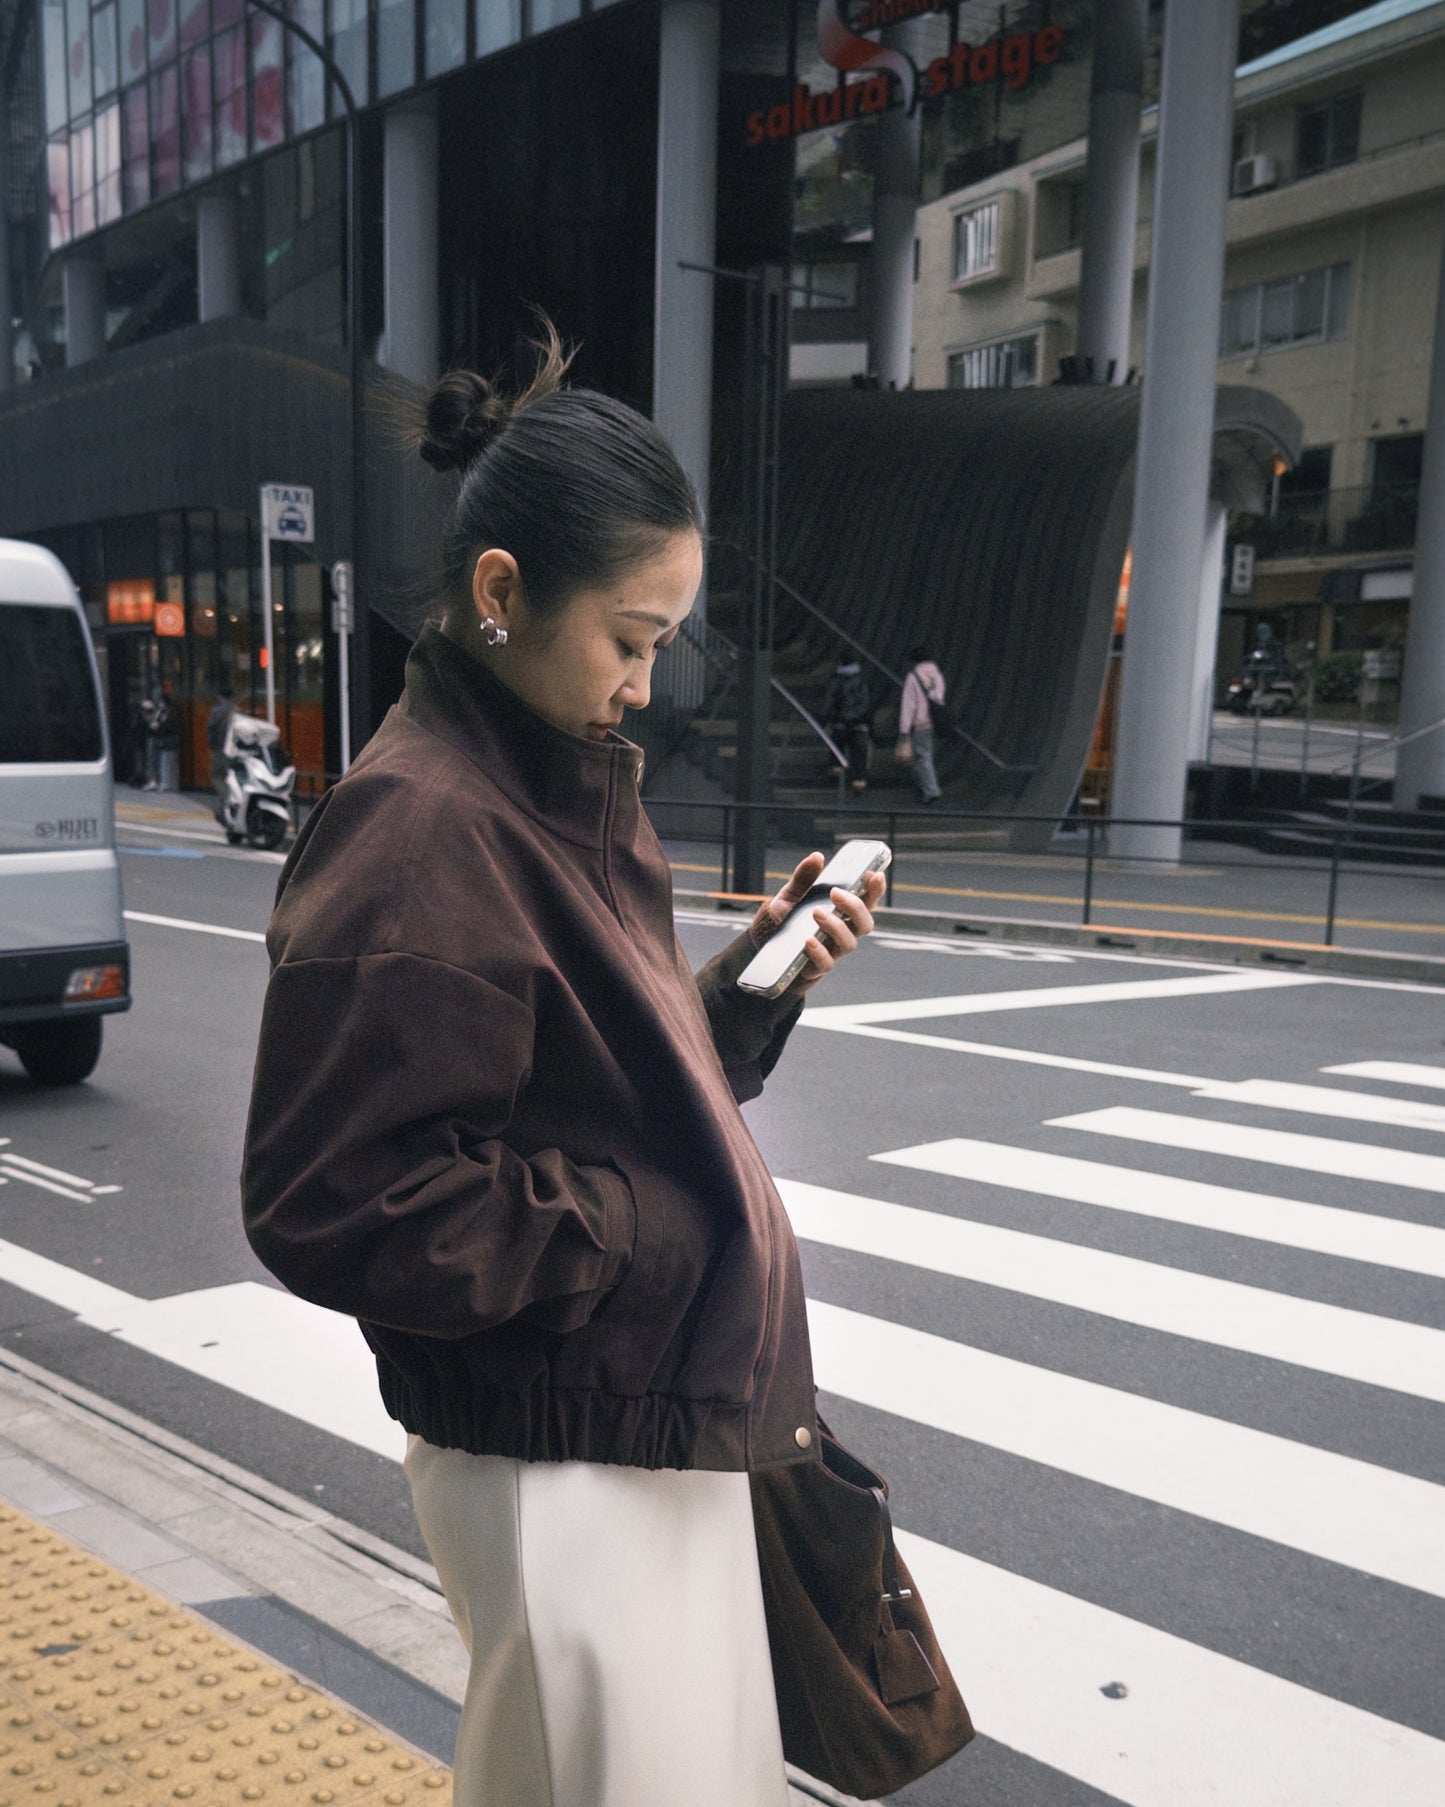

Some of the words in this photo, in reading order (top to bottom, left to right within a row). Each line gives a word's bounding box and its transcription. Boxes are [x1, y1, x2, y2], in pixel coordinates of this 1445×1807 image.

[748, 75, 887, 144] sakura
[927, 26, 1062, 96] stage
[272, 488, 310, 504] TAXI
[59, 819, 98, 834] HIJET
